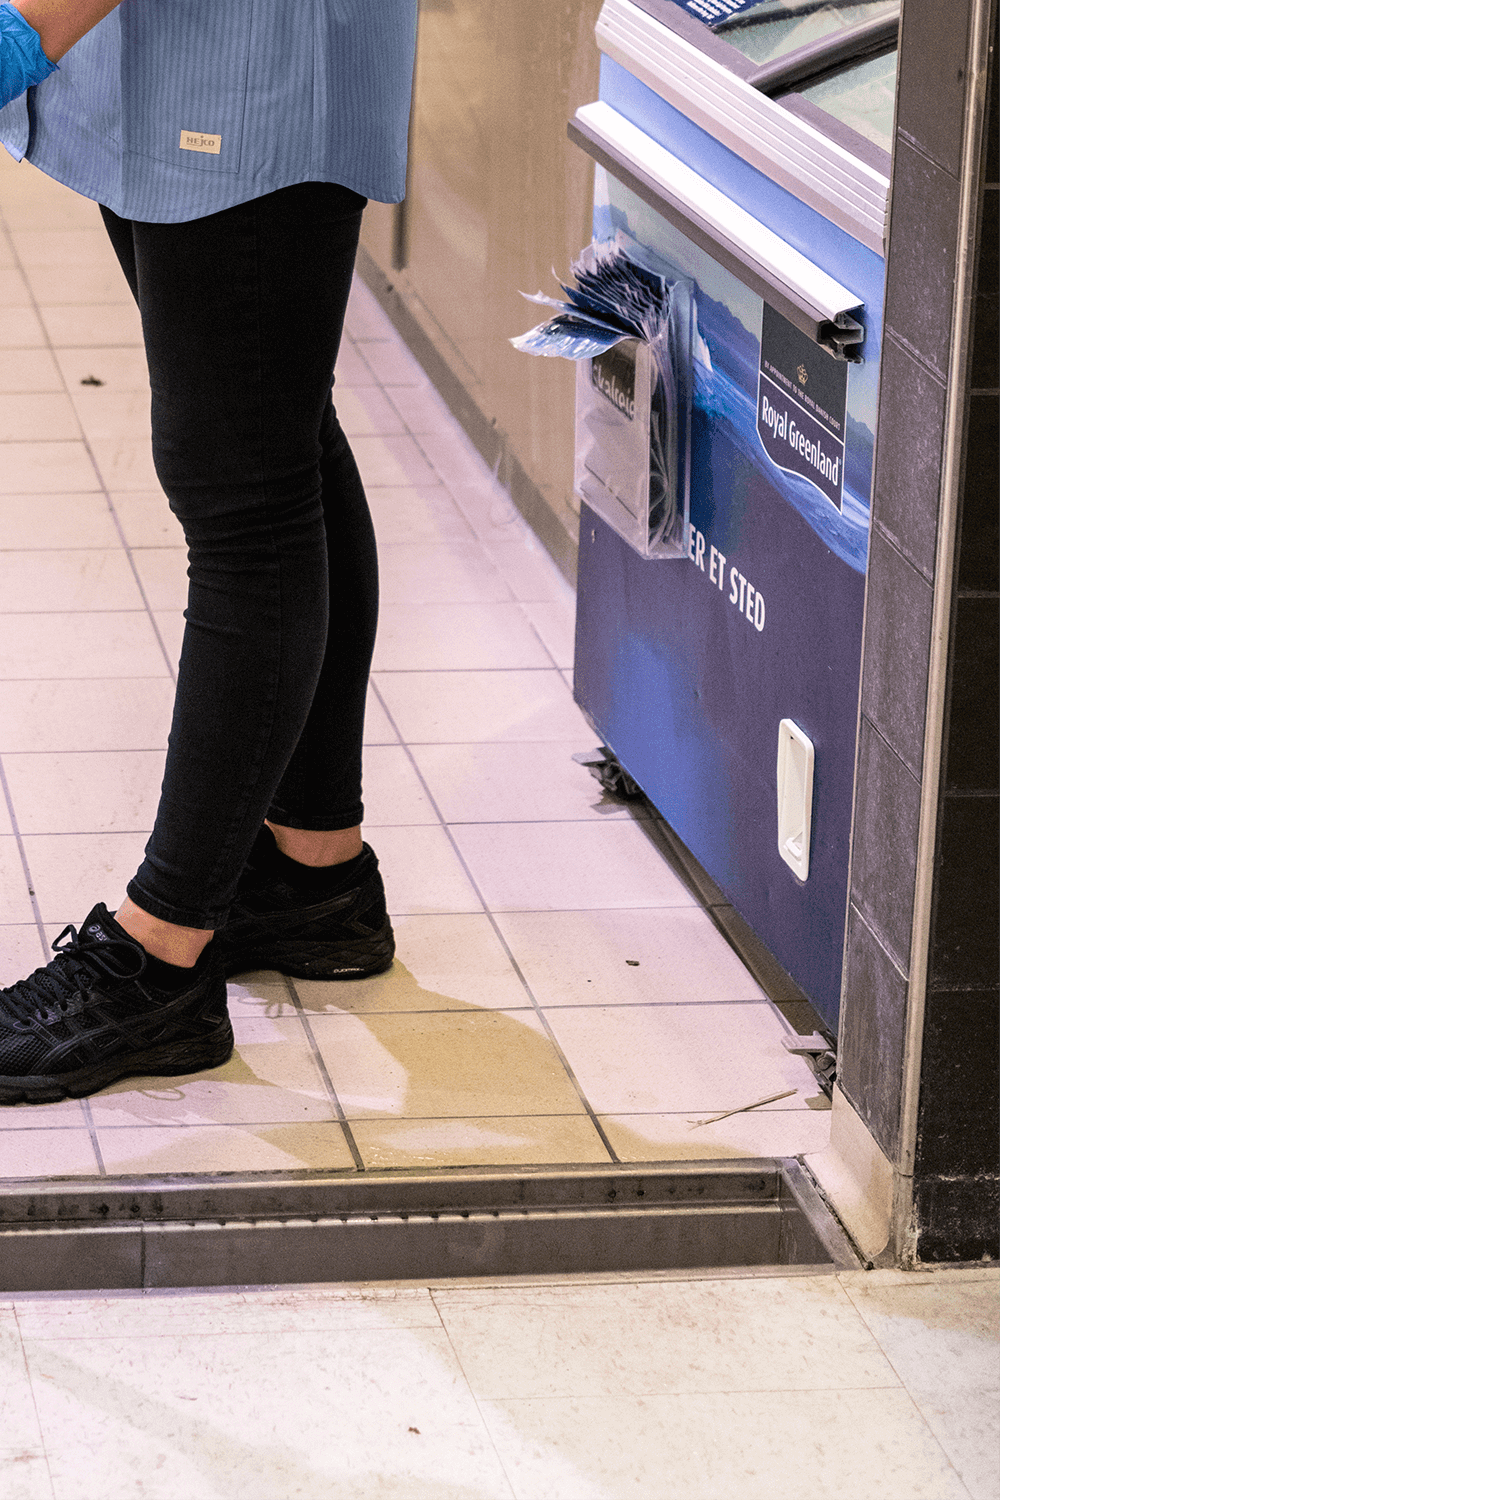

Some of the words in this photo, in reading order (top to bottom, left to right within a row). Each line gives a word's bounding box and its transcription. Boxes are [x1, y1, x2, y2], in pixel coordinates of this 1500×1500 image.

[761, 395, 789, 440] Royal
[788, 420, 840, 486] Greenland
[688, 522, 706, 573] ER
[709, 544, 727, 591] ET
[728, 566, 766, 632] STED
